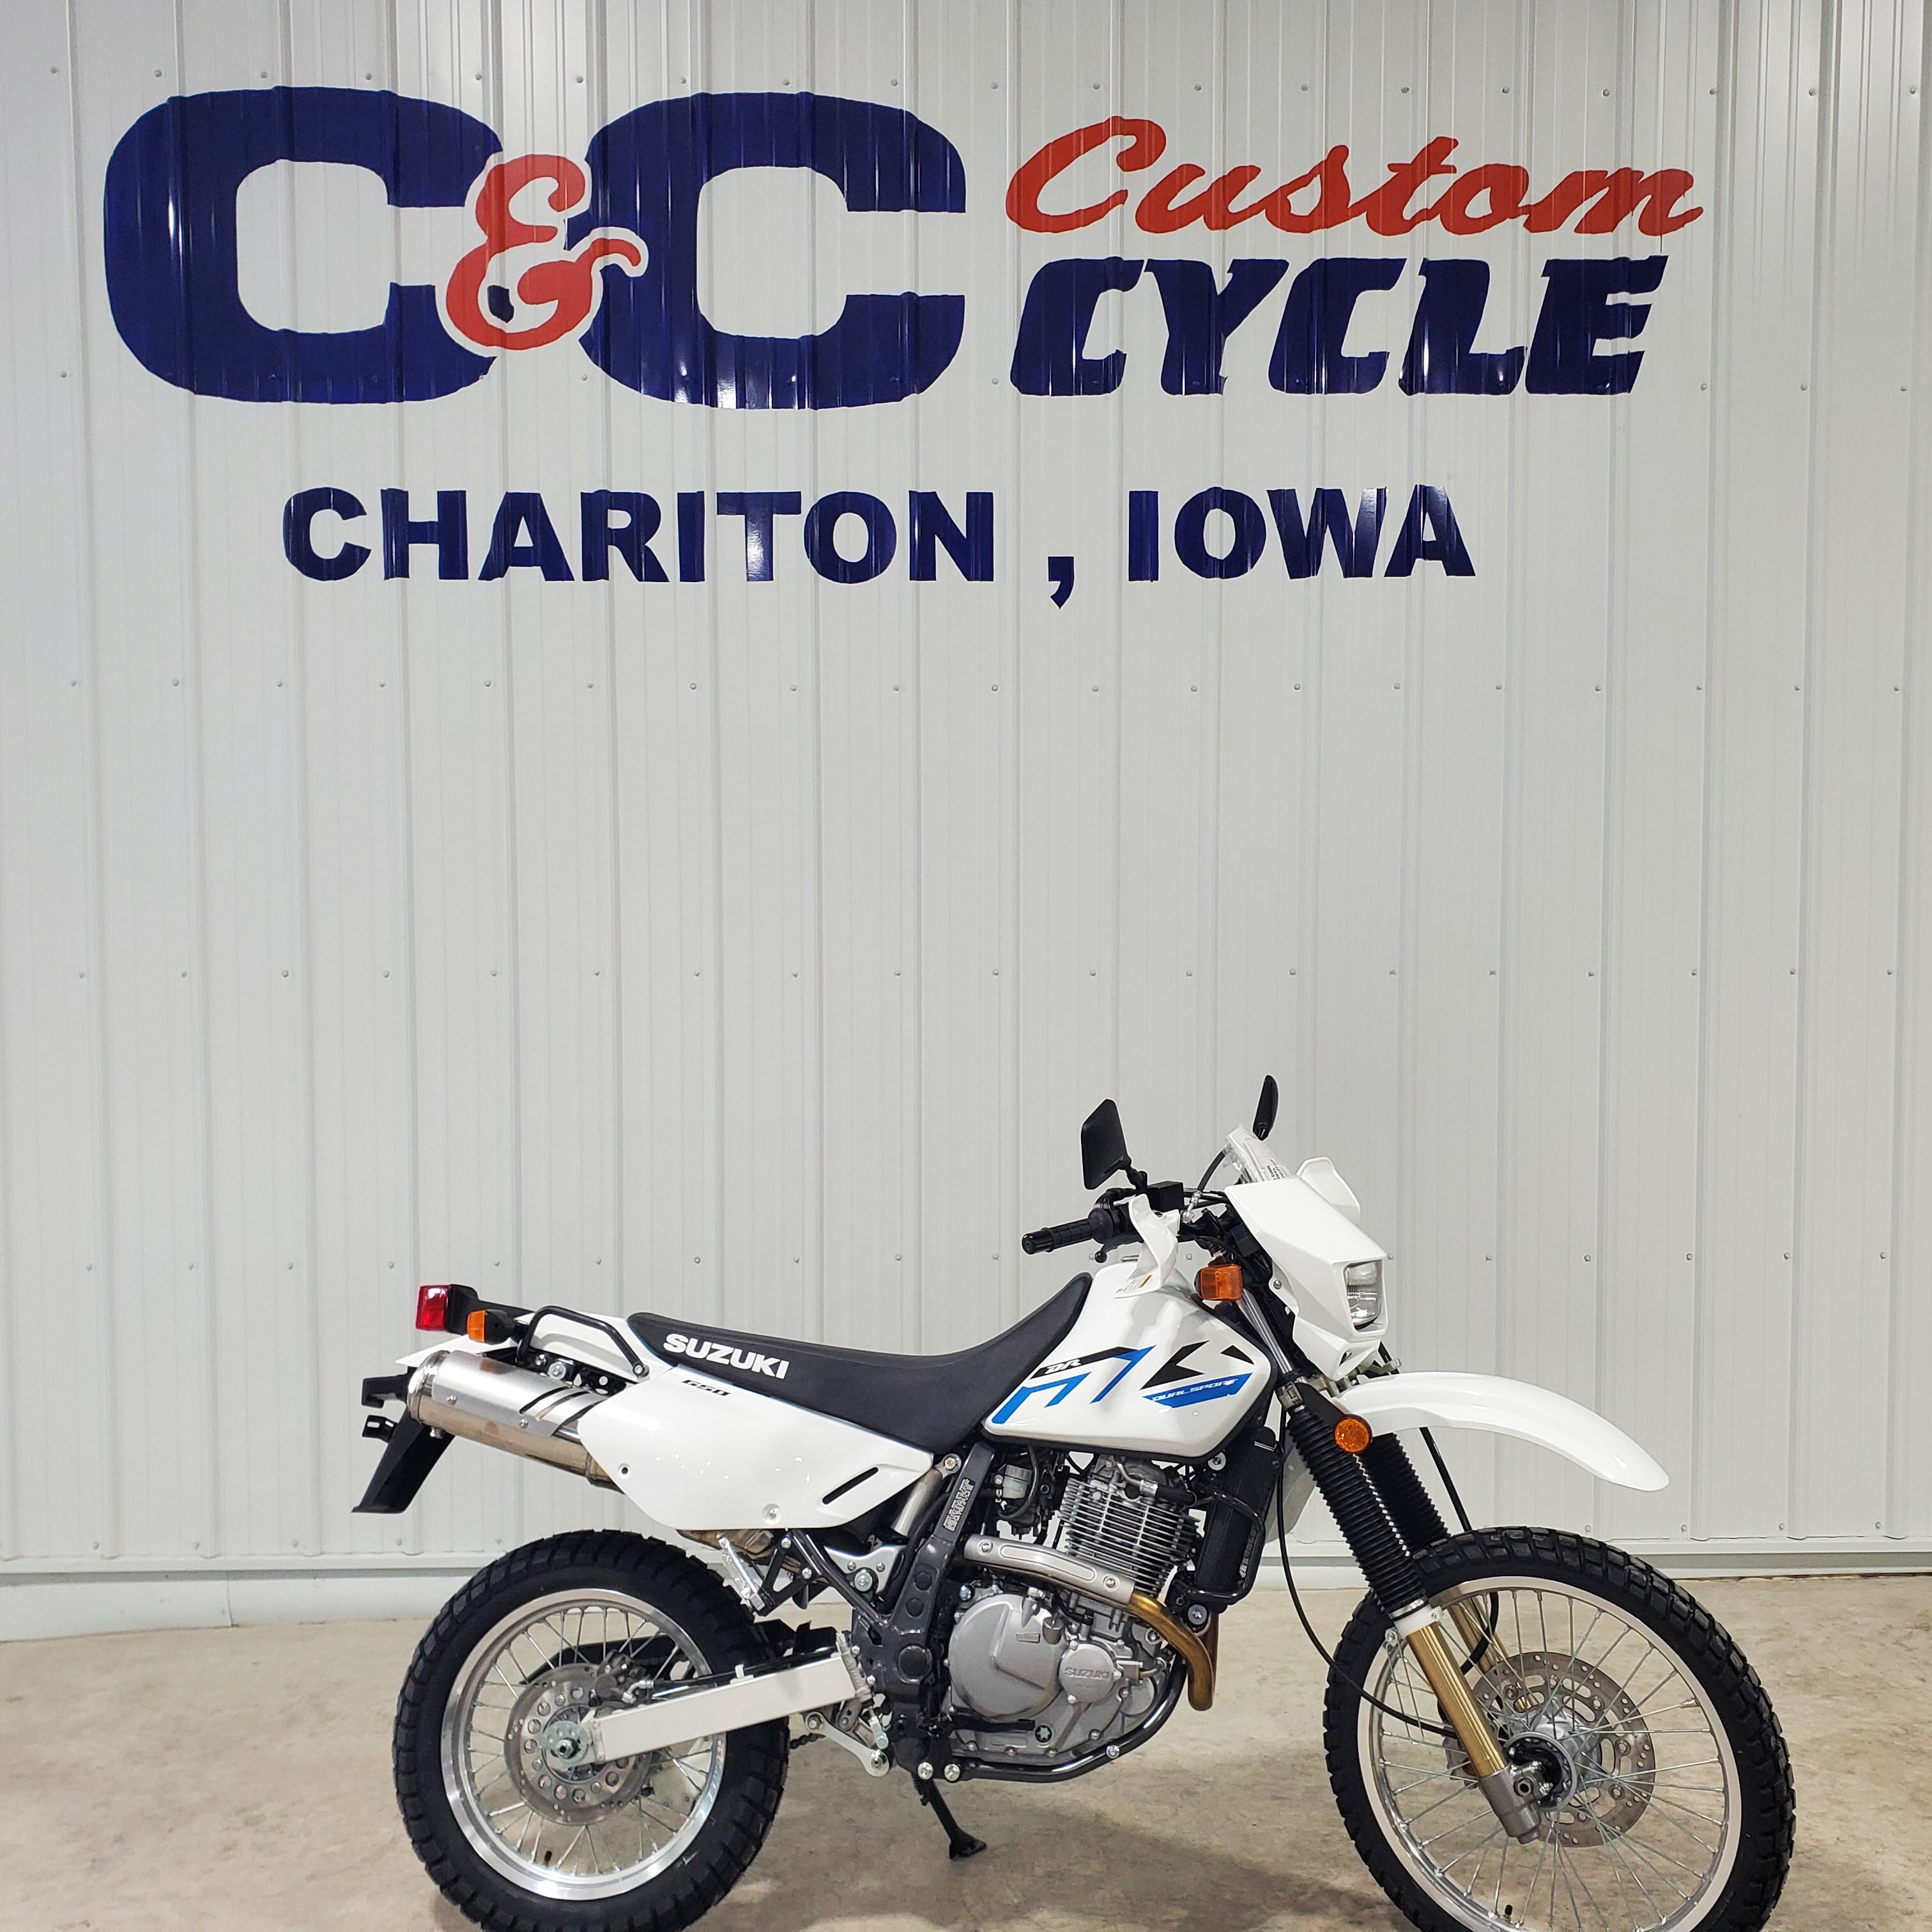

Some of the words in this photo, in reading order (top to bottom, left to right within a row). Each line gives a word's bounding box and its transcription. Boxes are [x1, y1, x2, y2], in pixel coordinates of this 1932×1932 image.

[1006, 116, 1703, 236] Custom
[103, 85, 966, 410] C&C
[1009, 255, 1668, 396] CYCLE
[282, 486, 995, 583] CHARITON
[1128, 486, 1476, 579] IOWA
[663, 1333, 790, 1379] SUZUKI
[681, 1379, 732, 1397] 650
[1064, 1667, 1110, 1681] SUZUKI
